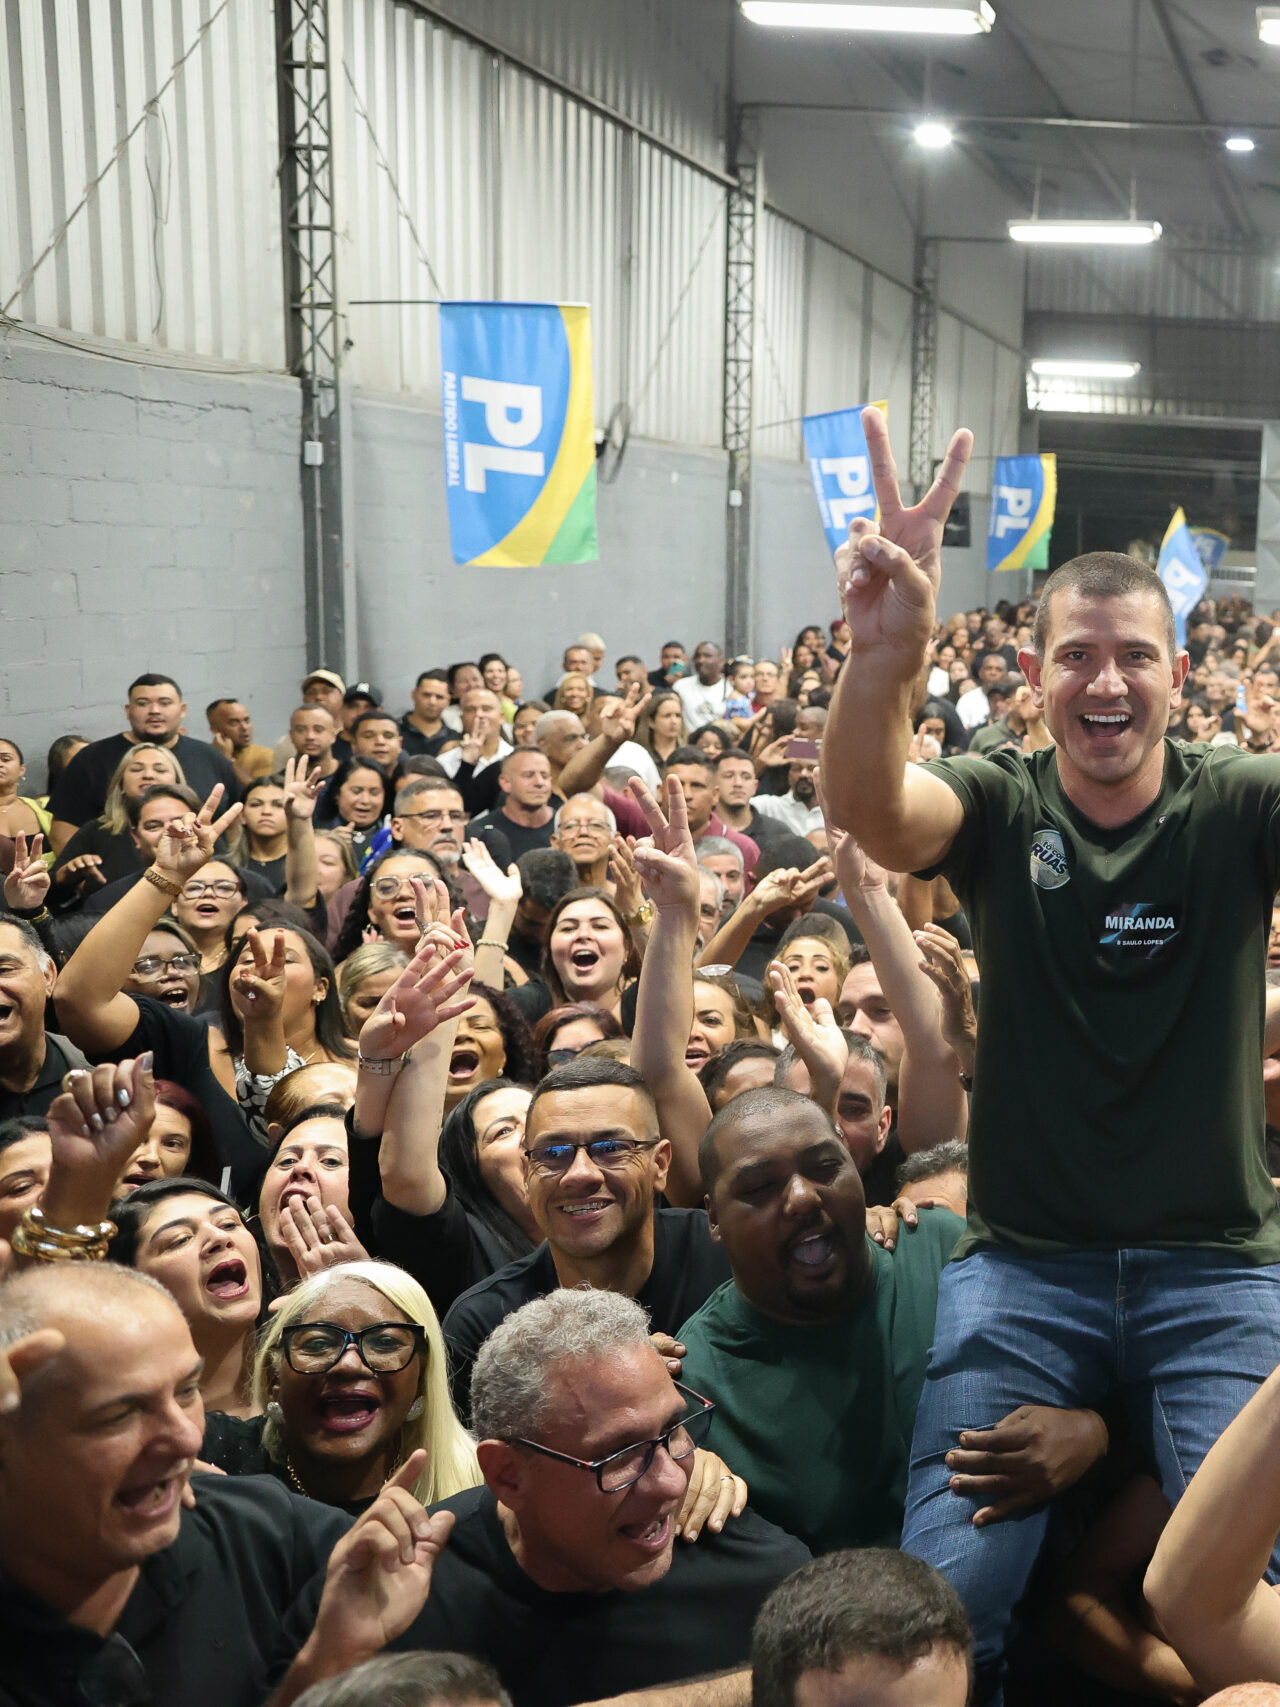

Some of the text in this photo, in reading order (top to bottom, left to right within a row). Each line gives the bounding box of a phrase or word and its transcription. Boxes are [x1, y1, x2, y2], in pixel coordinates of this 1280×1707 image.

[443, 371, 458, 432] PARTIDO
[462, 375, 544, 493] PL
[820, 456, 875, 530] PL
[996, 486, 1032, 538] PL
[1032, 843, 1068, 875] RUAS
[1105, 916, 1175, 930] MIRANDA
